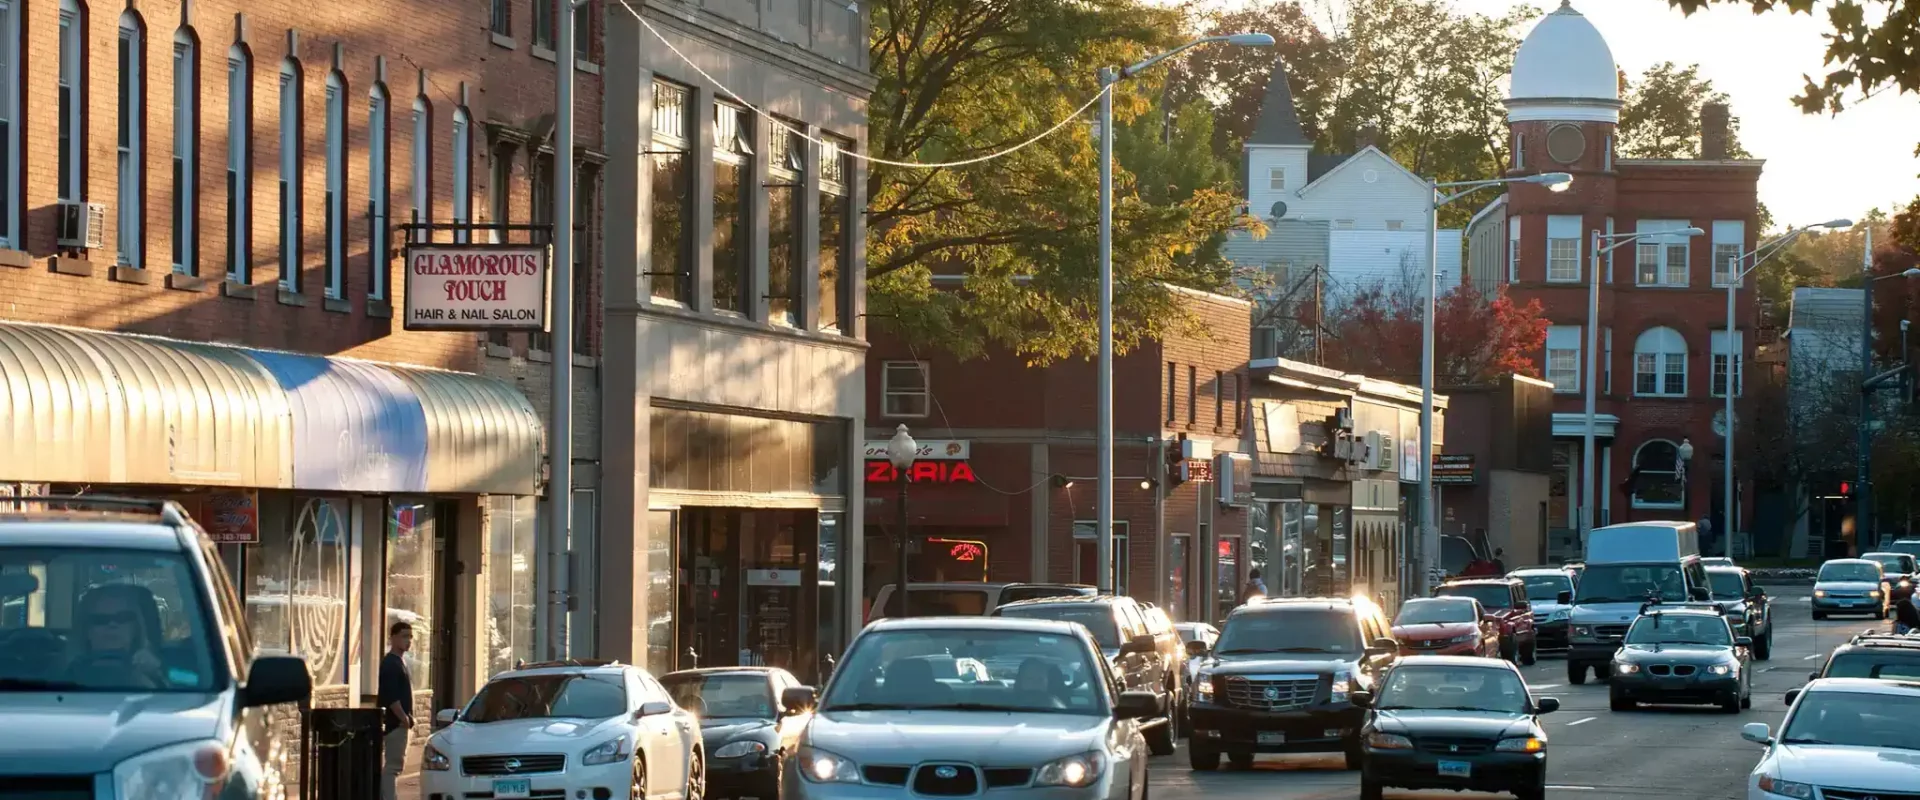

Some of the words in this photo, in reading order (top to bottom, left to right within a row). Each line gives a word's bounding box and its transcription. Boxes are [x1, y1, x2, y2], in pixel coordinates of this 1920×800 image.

[414, 254, 537, 276] GLAMOROUS
[443, 280, 507, 301] TOUCH
[414, 309, 444, 320] HAIR
[448, 308, 457, 320] &
[461, 309, 488, 320] NAIL
[493, 308, 536, 320] SALON
